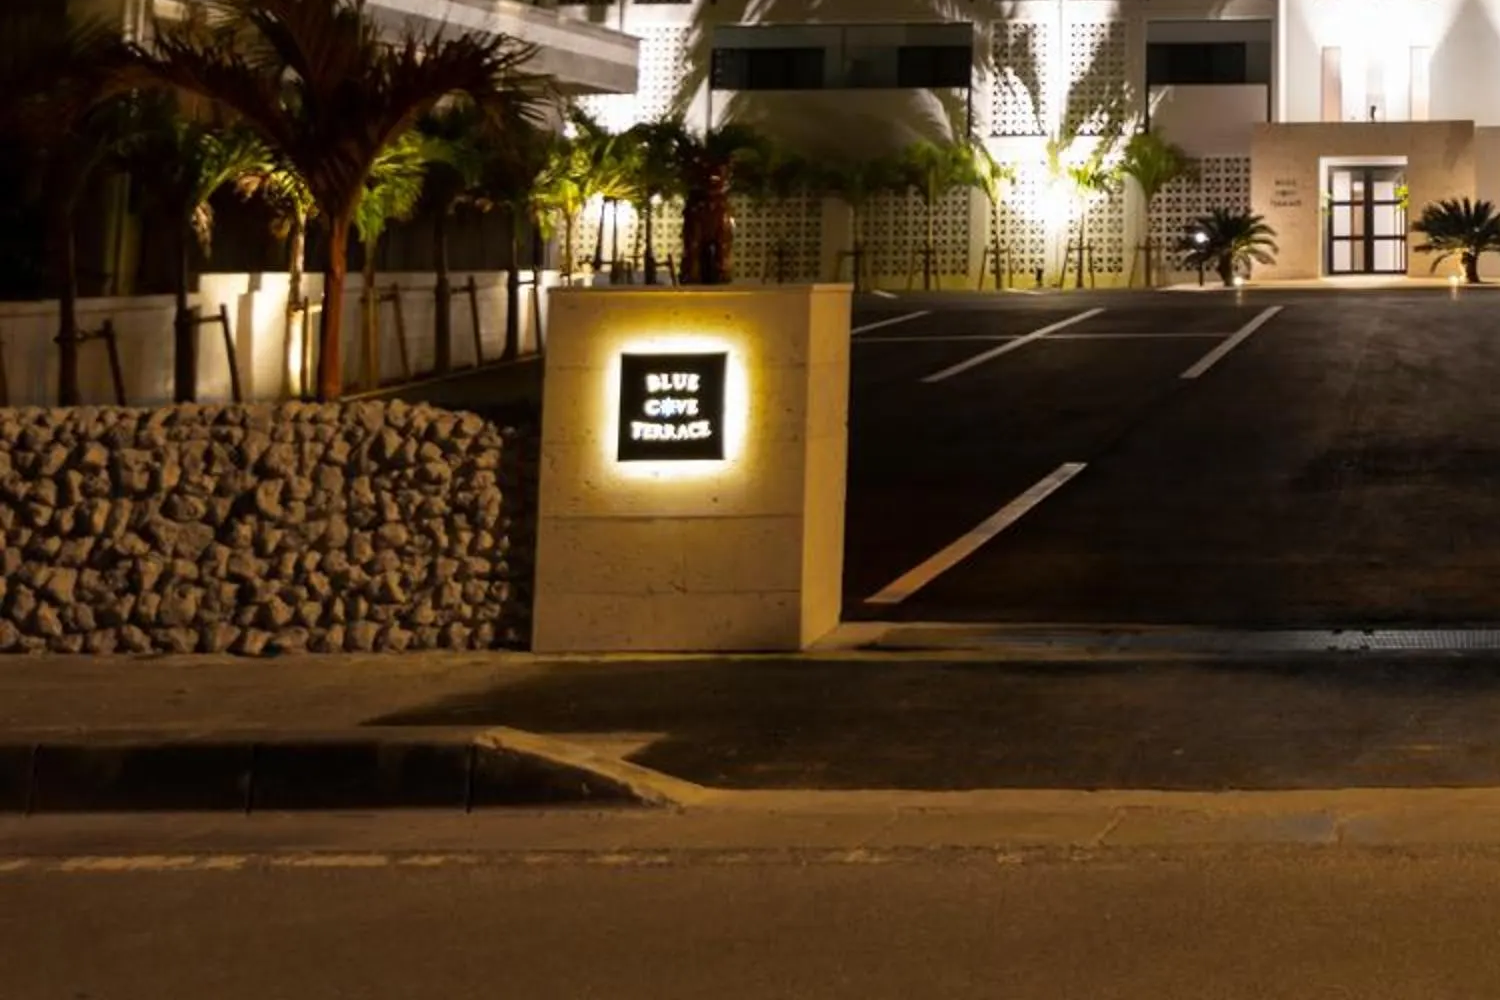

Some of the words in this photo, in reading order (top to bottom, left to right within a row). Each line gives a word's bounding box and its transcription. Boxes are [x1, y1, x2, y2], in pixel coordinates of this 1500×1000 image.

[646, 372, 700, 393] BLUE
[644, 396, 699, 418] CVE
[631, 420, 712, 441] TERRACE
